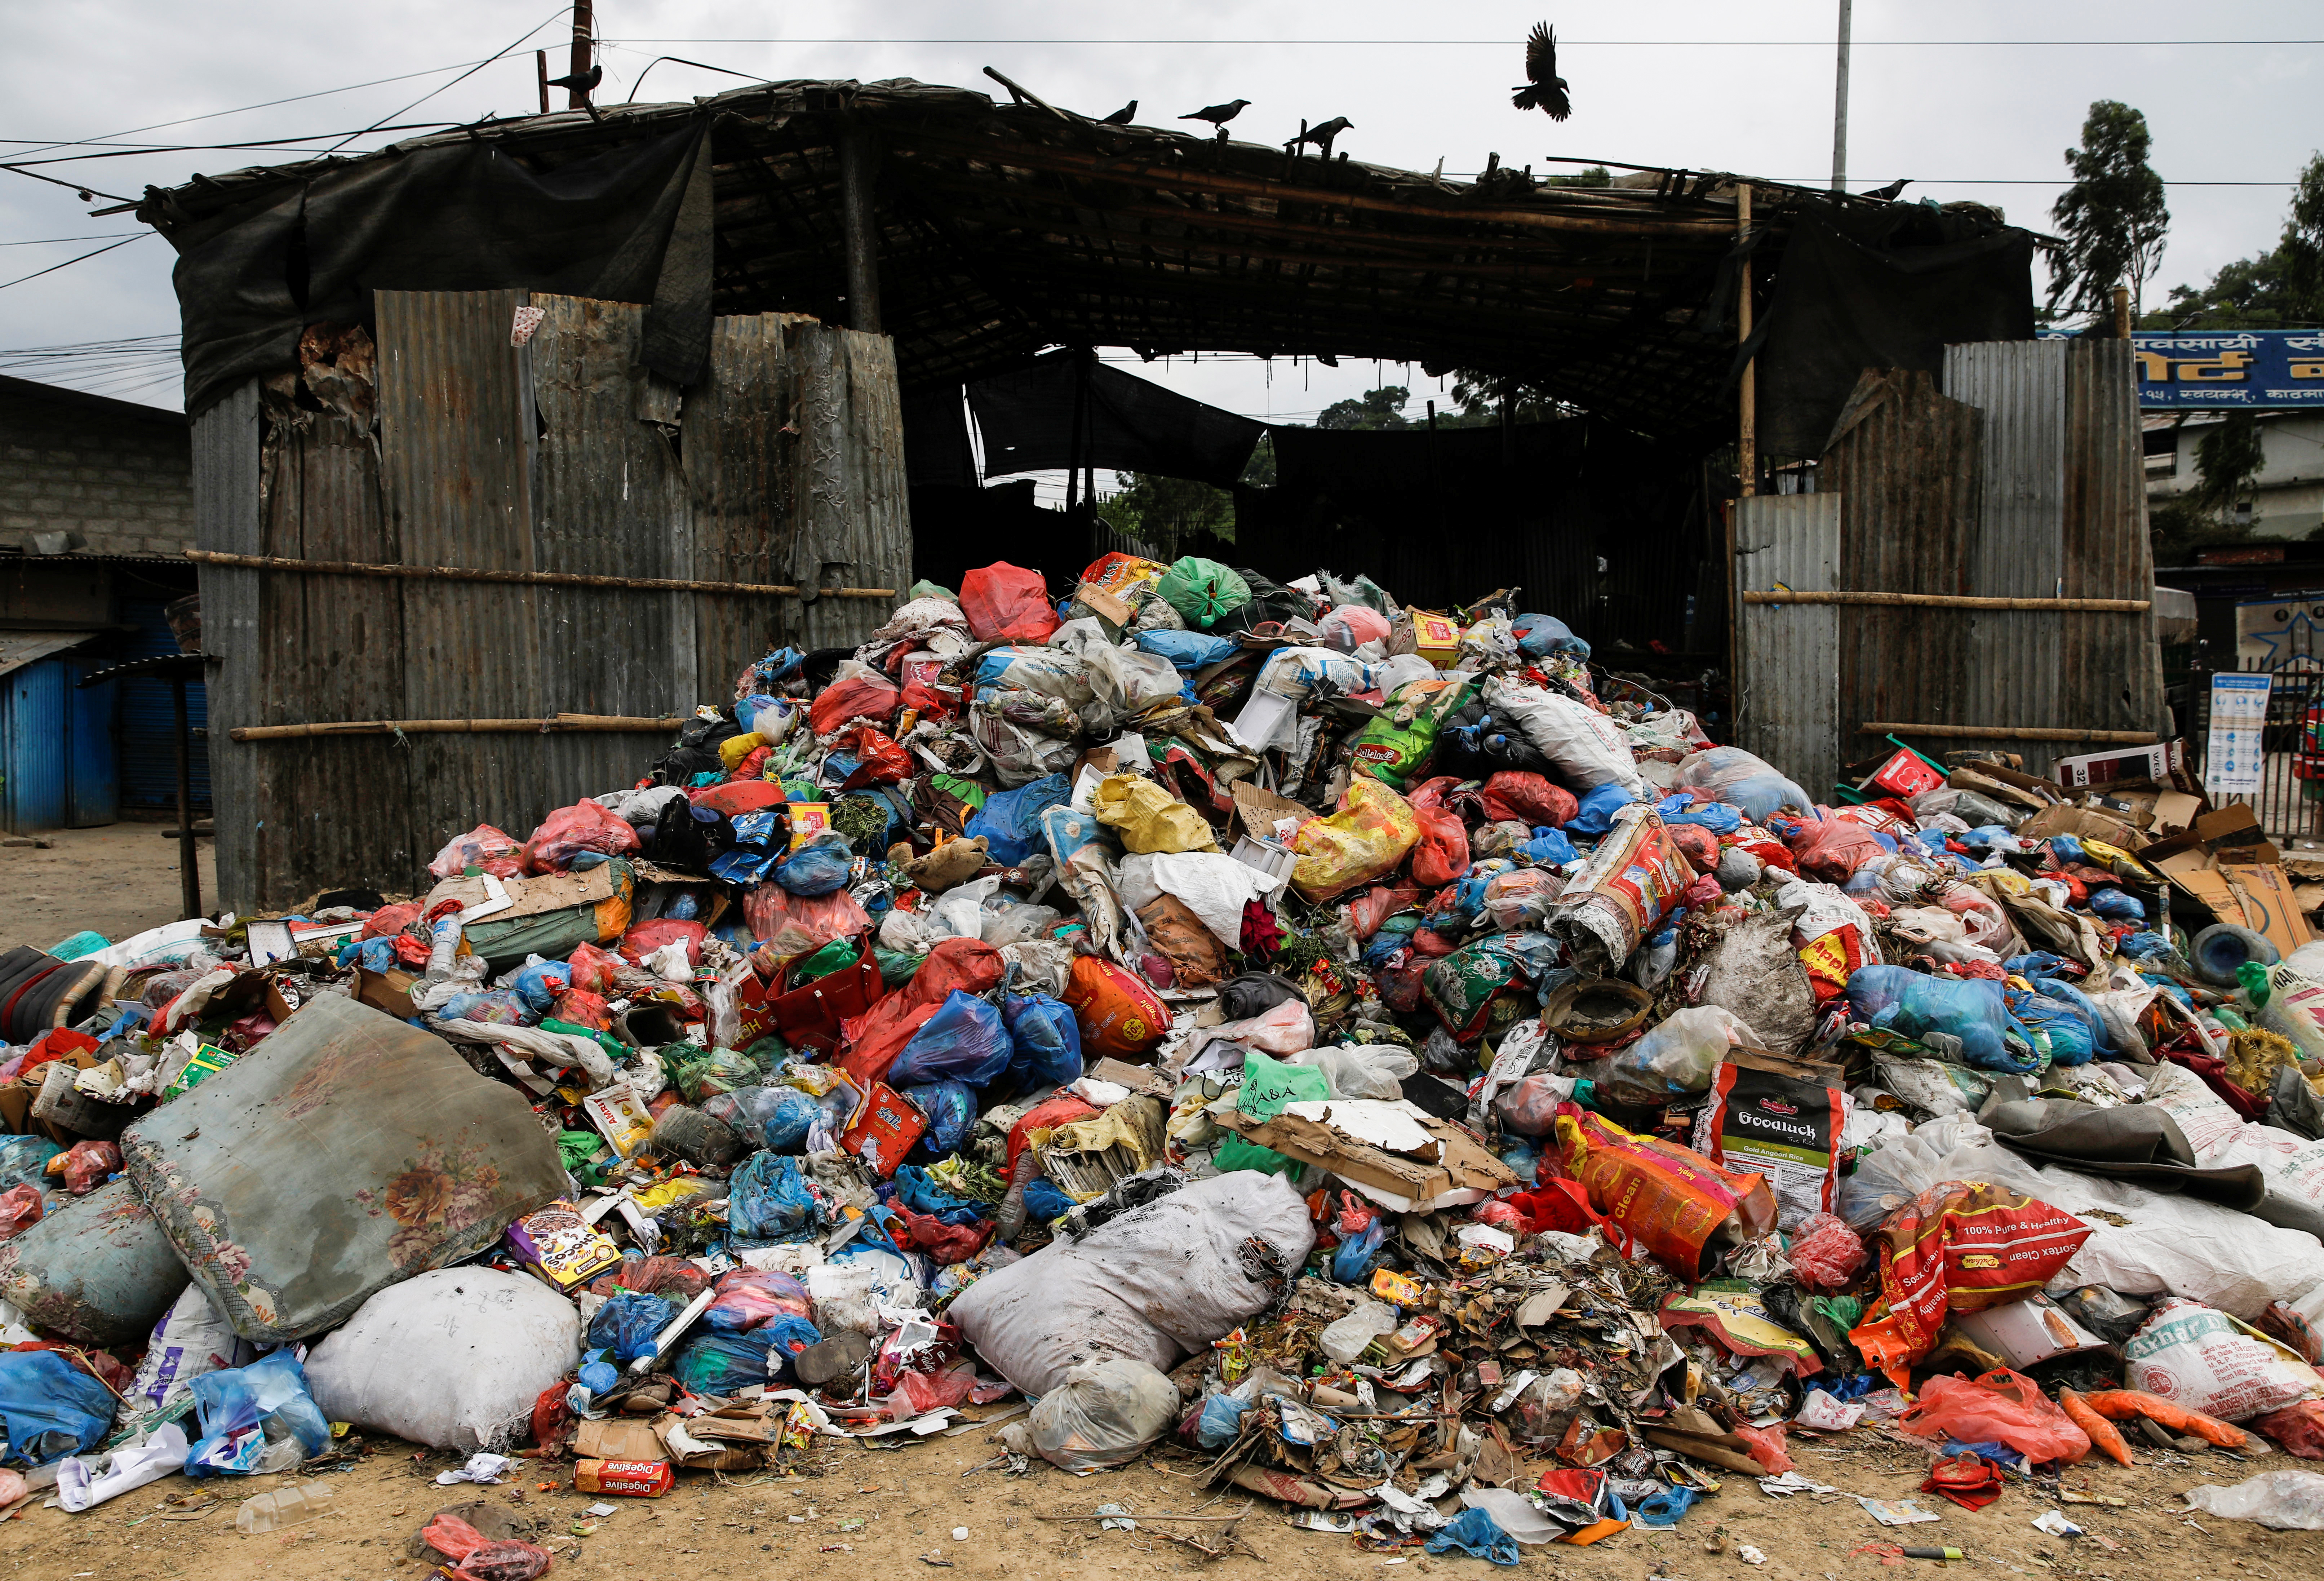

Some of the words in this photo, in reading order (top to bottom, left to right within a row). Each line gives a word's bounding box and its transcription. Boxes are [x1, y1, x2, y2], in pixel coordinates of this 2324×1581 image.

[1096, 957, 1114, 978] Apple
[1810, 941, 1850, 981] Apple
[1074, 995, 1093, 1017] Clean
[1140, 999, 1158, 1020] Apple
[593, 1098, 617, 1125] AMRIT
[1704, 1103, 1715, 1119] Rice
[1738, 1111, 1817, 1141] Goodluck
[1760, 1148, 1787, 1159] Angoori
[1771, 1143, 1791, 1152] Quality
[1677, 1166, 1697, 1181] Apple
[1778, 1169, 1802, 1177] Nutrition
[1615, 1177, 1642, 1218] Clean
[1677, 1216, 1688, 1228] Net
[1964, 1225, 1992, 1236] 100%
[1995, 1223, 2017, 1235] Pure
[2020, 1221, 2028, 1229] &
[2030, 1216, 2070, 1230] Healthy
[546, 1234, 599, 1267] CHOCOS
[2009, 1250, 2041, 1261] Clean
[2041, 1243, 2078, 1258] Sortex
[1919, 1287, 1947, 1316] Healthy
[2130, 1321, 2201, 1358] Arhar
[608, 1462, 654, 1475] Digestive
[606, 1480, 651, 1493] Digestive
